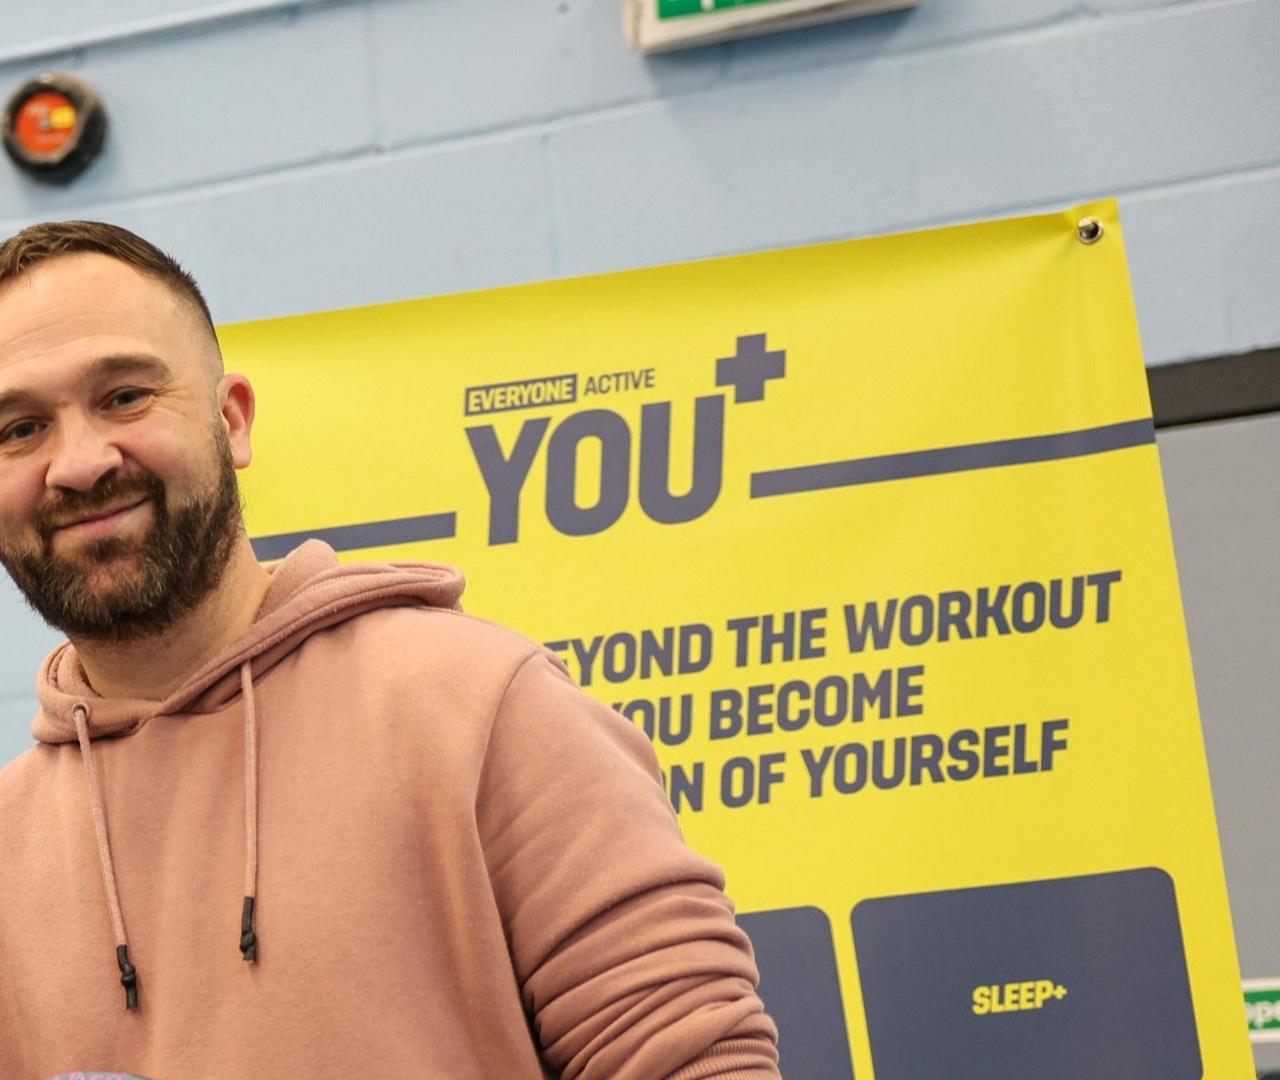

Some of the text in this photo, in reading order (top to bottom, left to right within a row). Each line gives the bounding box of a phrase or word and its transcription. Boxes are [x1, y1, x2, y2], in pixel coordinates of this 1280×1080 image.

[468, 368, 655, 413] EVERYONE ACTIVE
[726, 608, 828, 668] THE
[843, 569, 1123, 653] WORKOUT
[709, 664, 925, 740] BECOME
[721, 752, 786, 809] OF
[801, 718, 1070, 799] YOURSELF
[973, 980, 1066, 1014] SLEEP+
